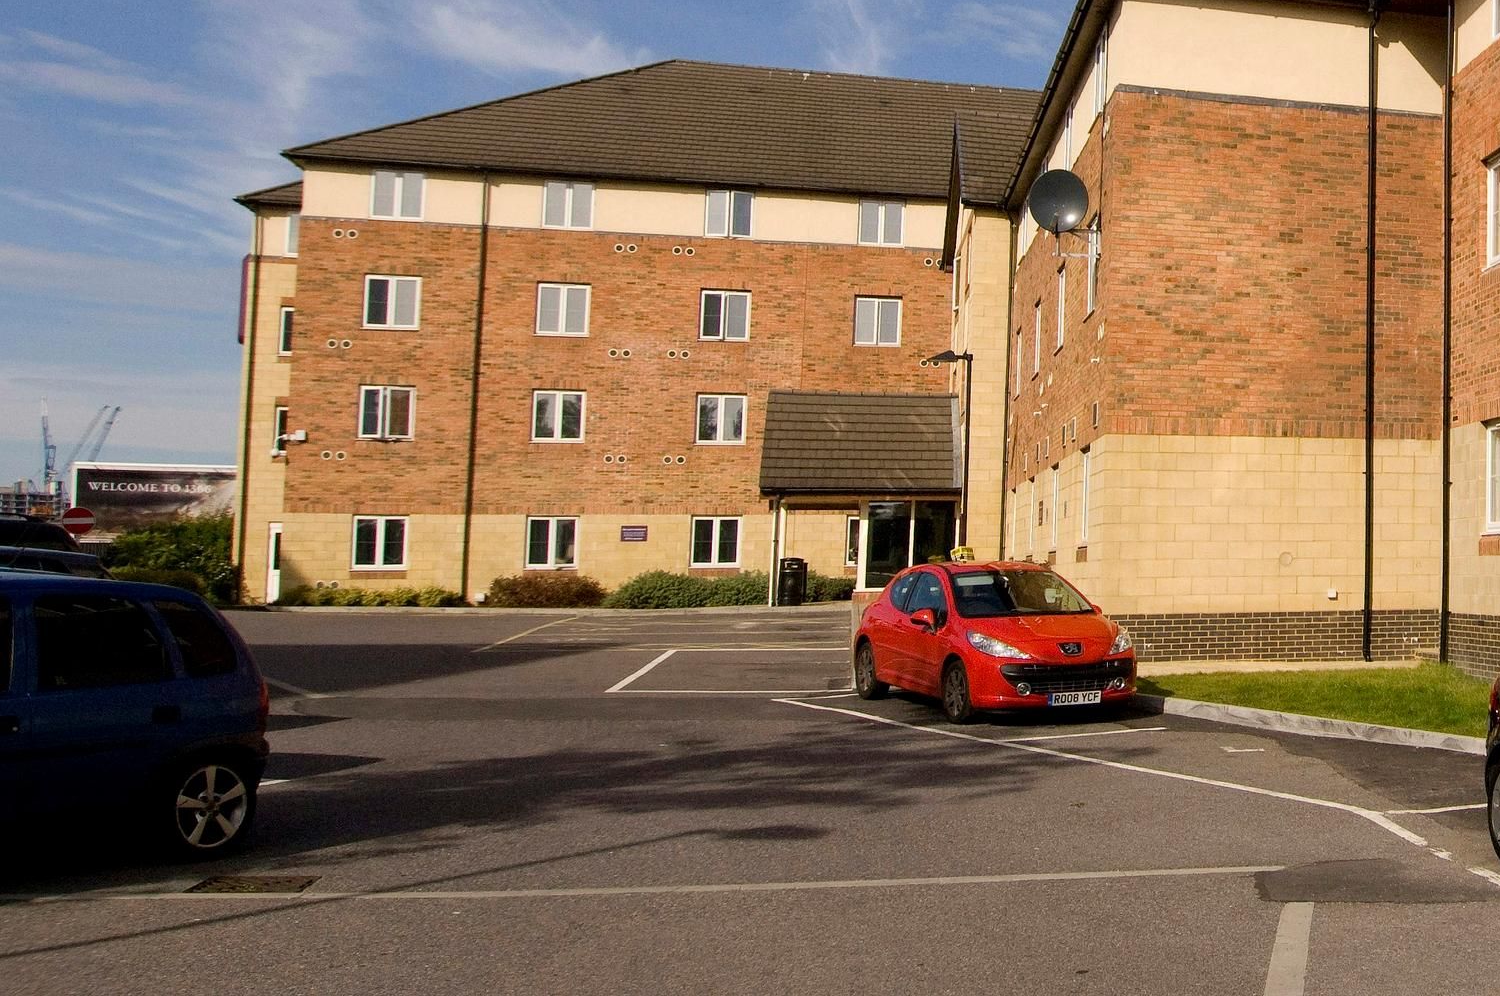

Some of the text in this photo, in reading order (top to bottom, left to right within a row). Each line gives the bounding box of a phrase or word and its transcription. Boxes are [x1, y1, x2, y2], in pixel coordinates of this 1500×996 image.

[88, 481, 159, 493] WELCOME
[162, 483, 182, 493] TO
[1081, 692, 1100, 702] YCF
